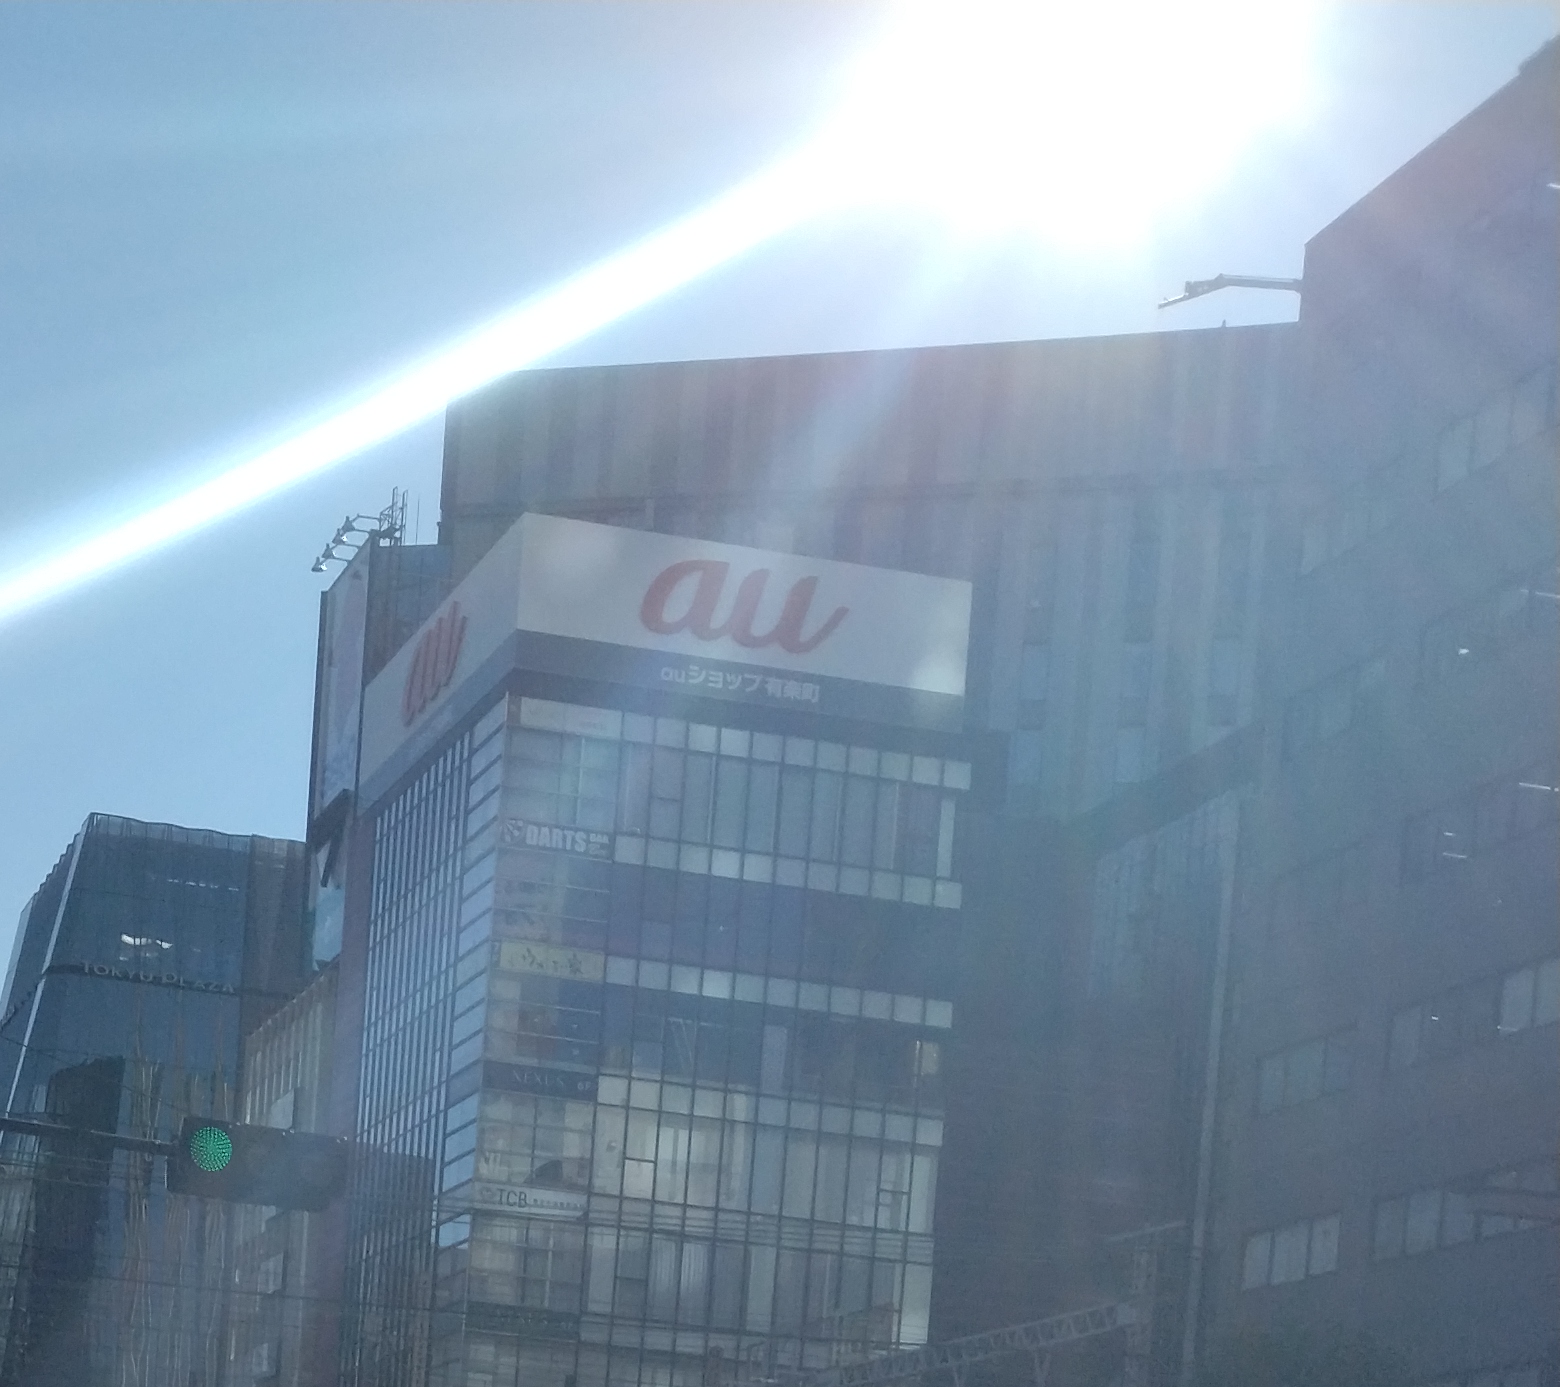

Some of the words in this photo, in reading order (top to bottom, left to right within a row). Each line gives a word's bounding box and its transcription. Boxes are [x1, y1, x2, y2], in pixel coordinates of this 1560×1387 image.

[640, 558, 849, 655] au
[525, 824, 588, 853] DARTS
[80, 960, 154, 983] TOKYU
[161, 970, 237, 995] PLAZA
[496, 1188, 528, 1209] TCB
